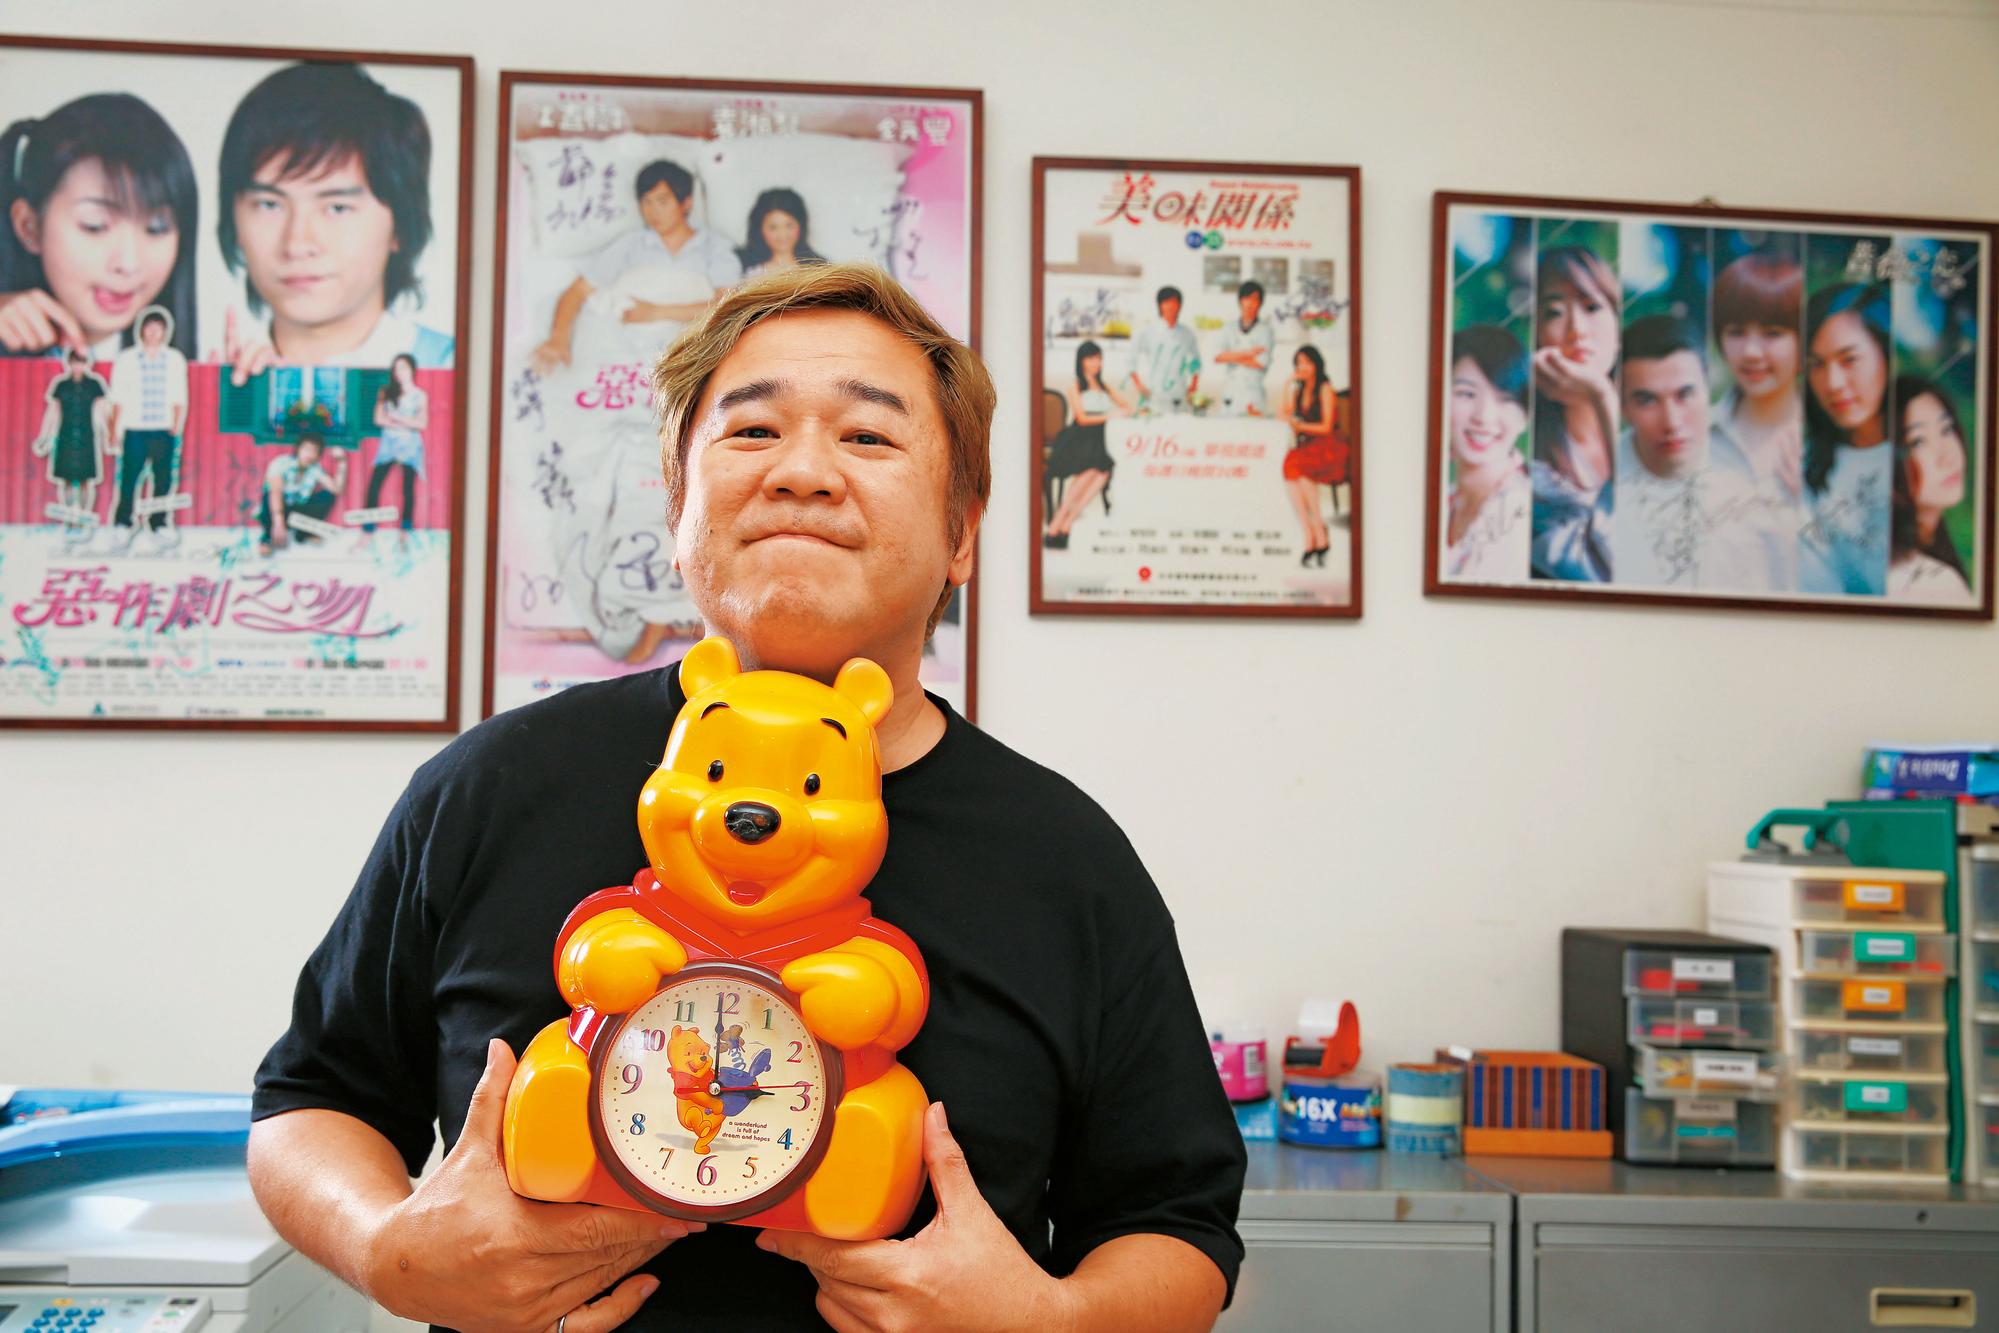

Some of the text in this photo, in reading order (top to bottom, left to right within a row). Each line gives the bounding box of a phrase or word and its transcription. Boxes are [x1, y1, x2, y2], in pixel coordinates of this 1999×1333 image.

[1095, 171, 1300, 231] 美味關係
[1125, 432, 1180, 459] 9/16
[13, 566, 402, 638] 惡作劇之吻
[1910, 758, 1960, 782] Double
[672, 999, 696, 1023] 11
[714, 991, 741, 1015] 12
[762, 1008, 774, 1031] 1
[640, 1028, 665, 1052] 10
[787, 1040, 803, 1063] 2
[621, 1063, 643, 1095] 9
[789, 1080, 811, 1112] 3
[1297, 1095, 1337, 1122] 16X
[629, 1112, 646, 1136] 8
[777, 1127, 793, 1150] 4
[659, 1147, 675, 1170] 7
[742, 1156, 759, 1179] 5
[696, 1155, 717, 1187] 6
